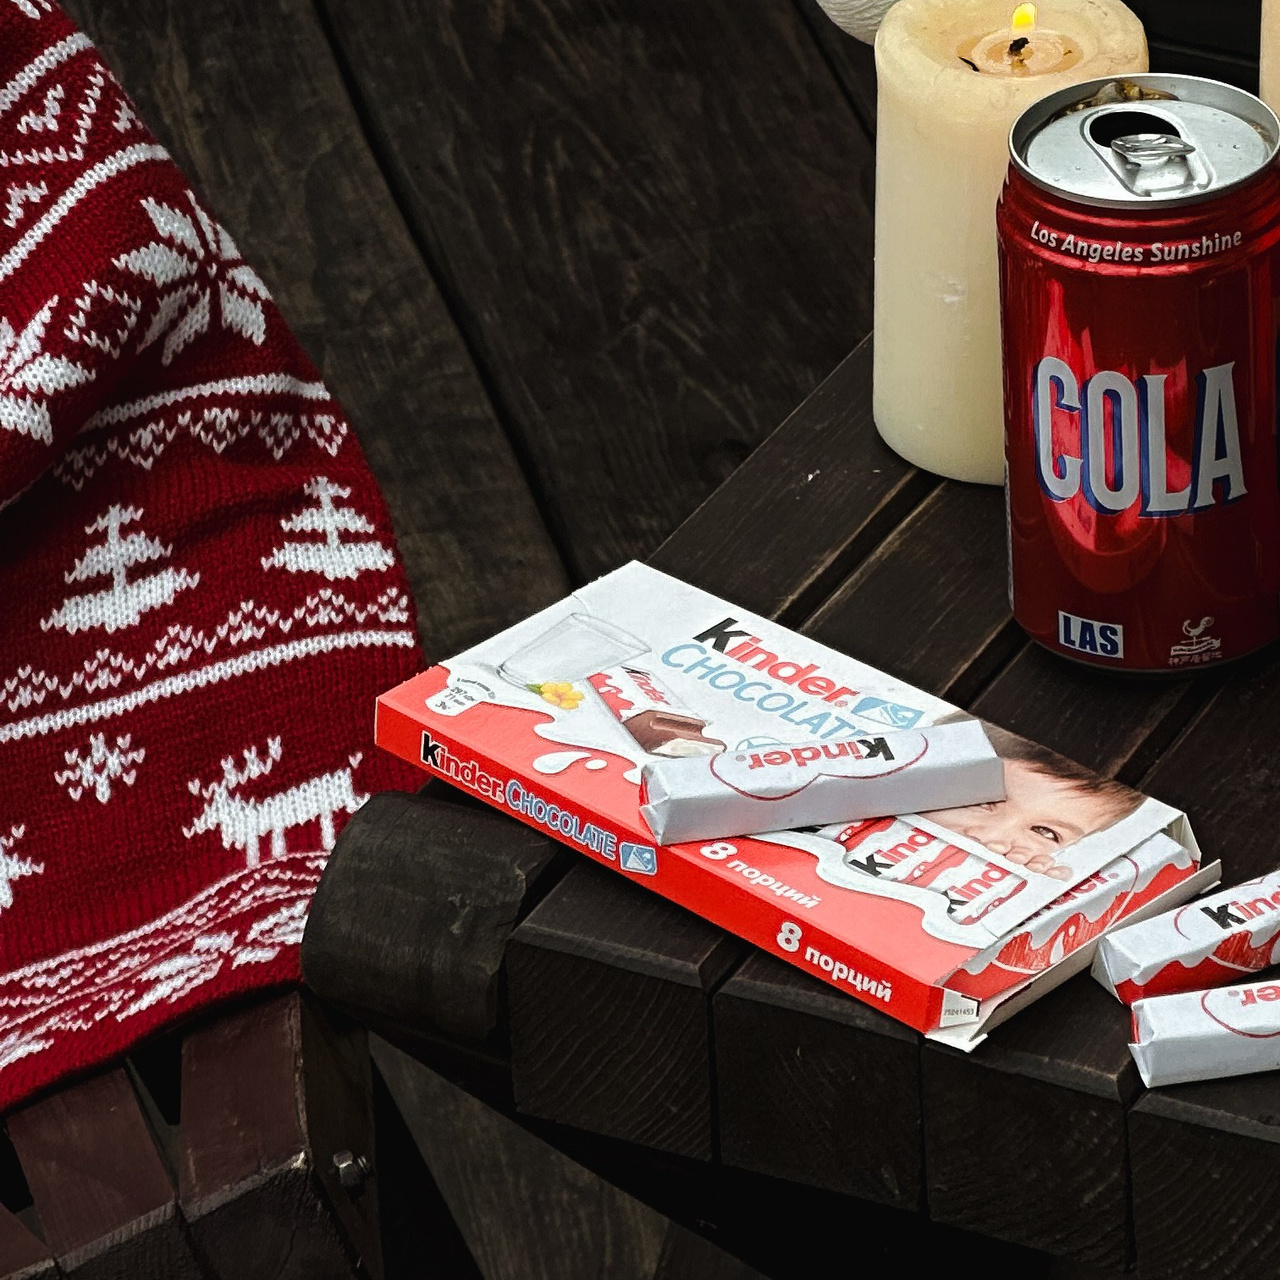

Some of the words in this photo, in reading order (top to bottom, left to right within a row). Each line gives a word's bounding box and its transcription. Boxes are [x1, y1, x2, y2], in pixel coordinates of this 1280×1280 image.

[1030, 220, 1057, 247] Los
[1061, 234, 1143, 263] Angeles
[1150, 231, 1242, 262] Sunshine
[1033, 355, 1248, 519] COLA
[1062, 614, 1119, 656] LAS
[661, 643, 872, 740] CHOCOLAT
[506, 778, 618, 861] CHOCOLATE
[699, 841, 738, 860] 8
[726, 859, 823, 909] порций
[776, 921, 803, 953] 8
[804, 946, 892, 1003] порций
